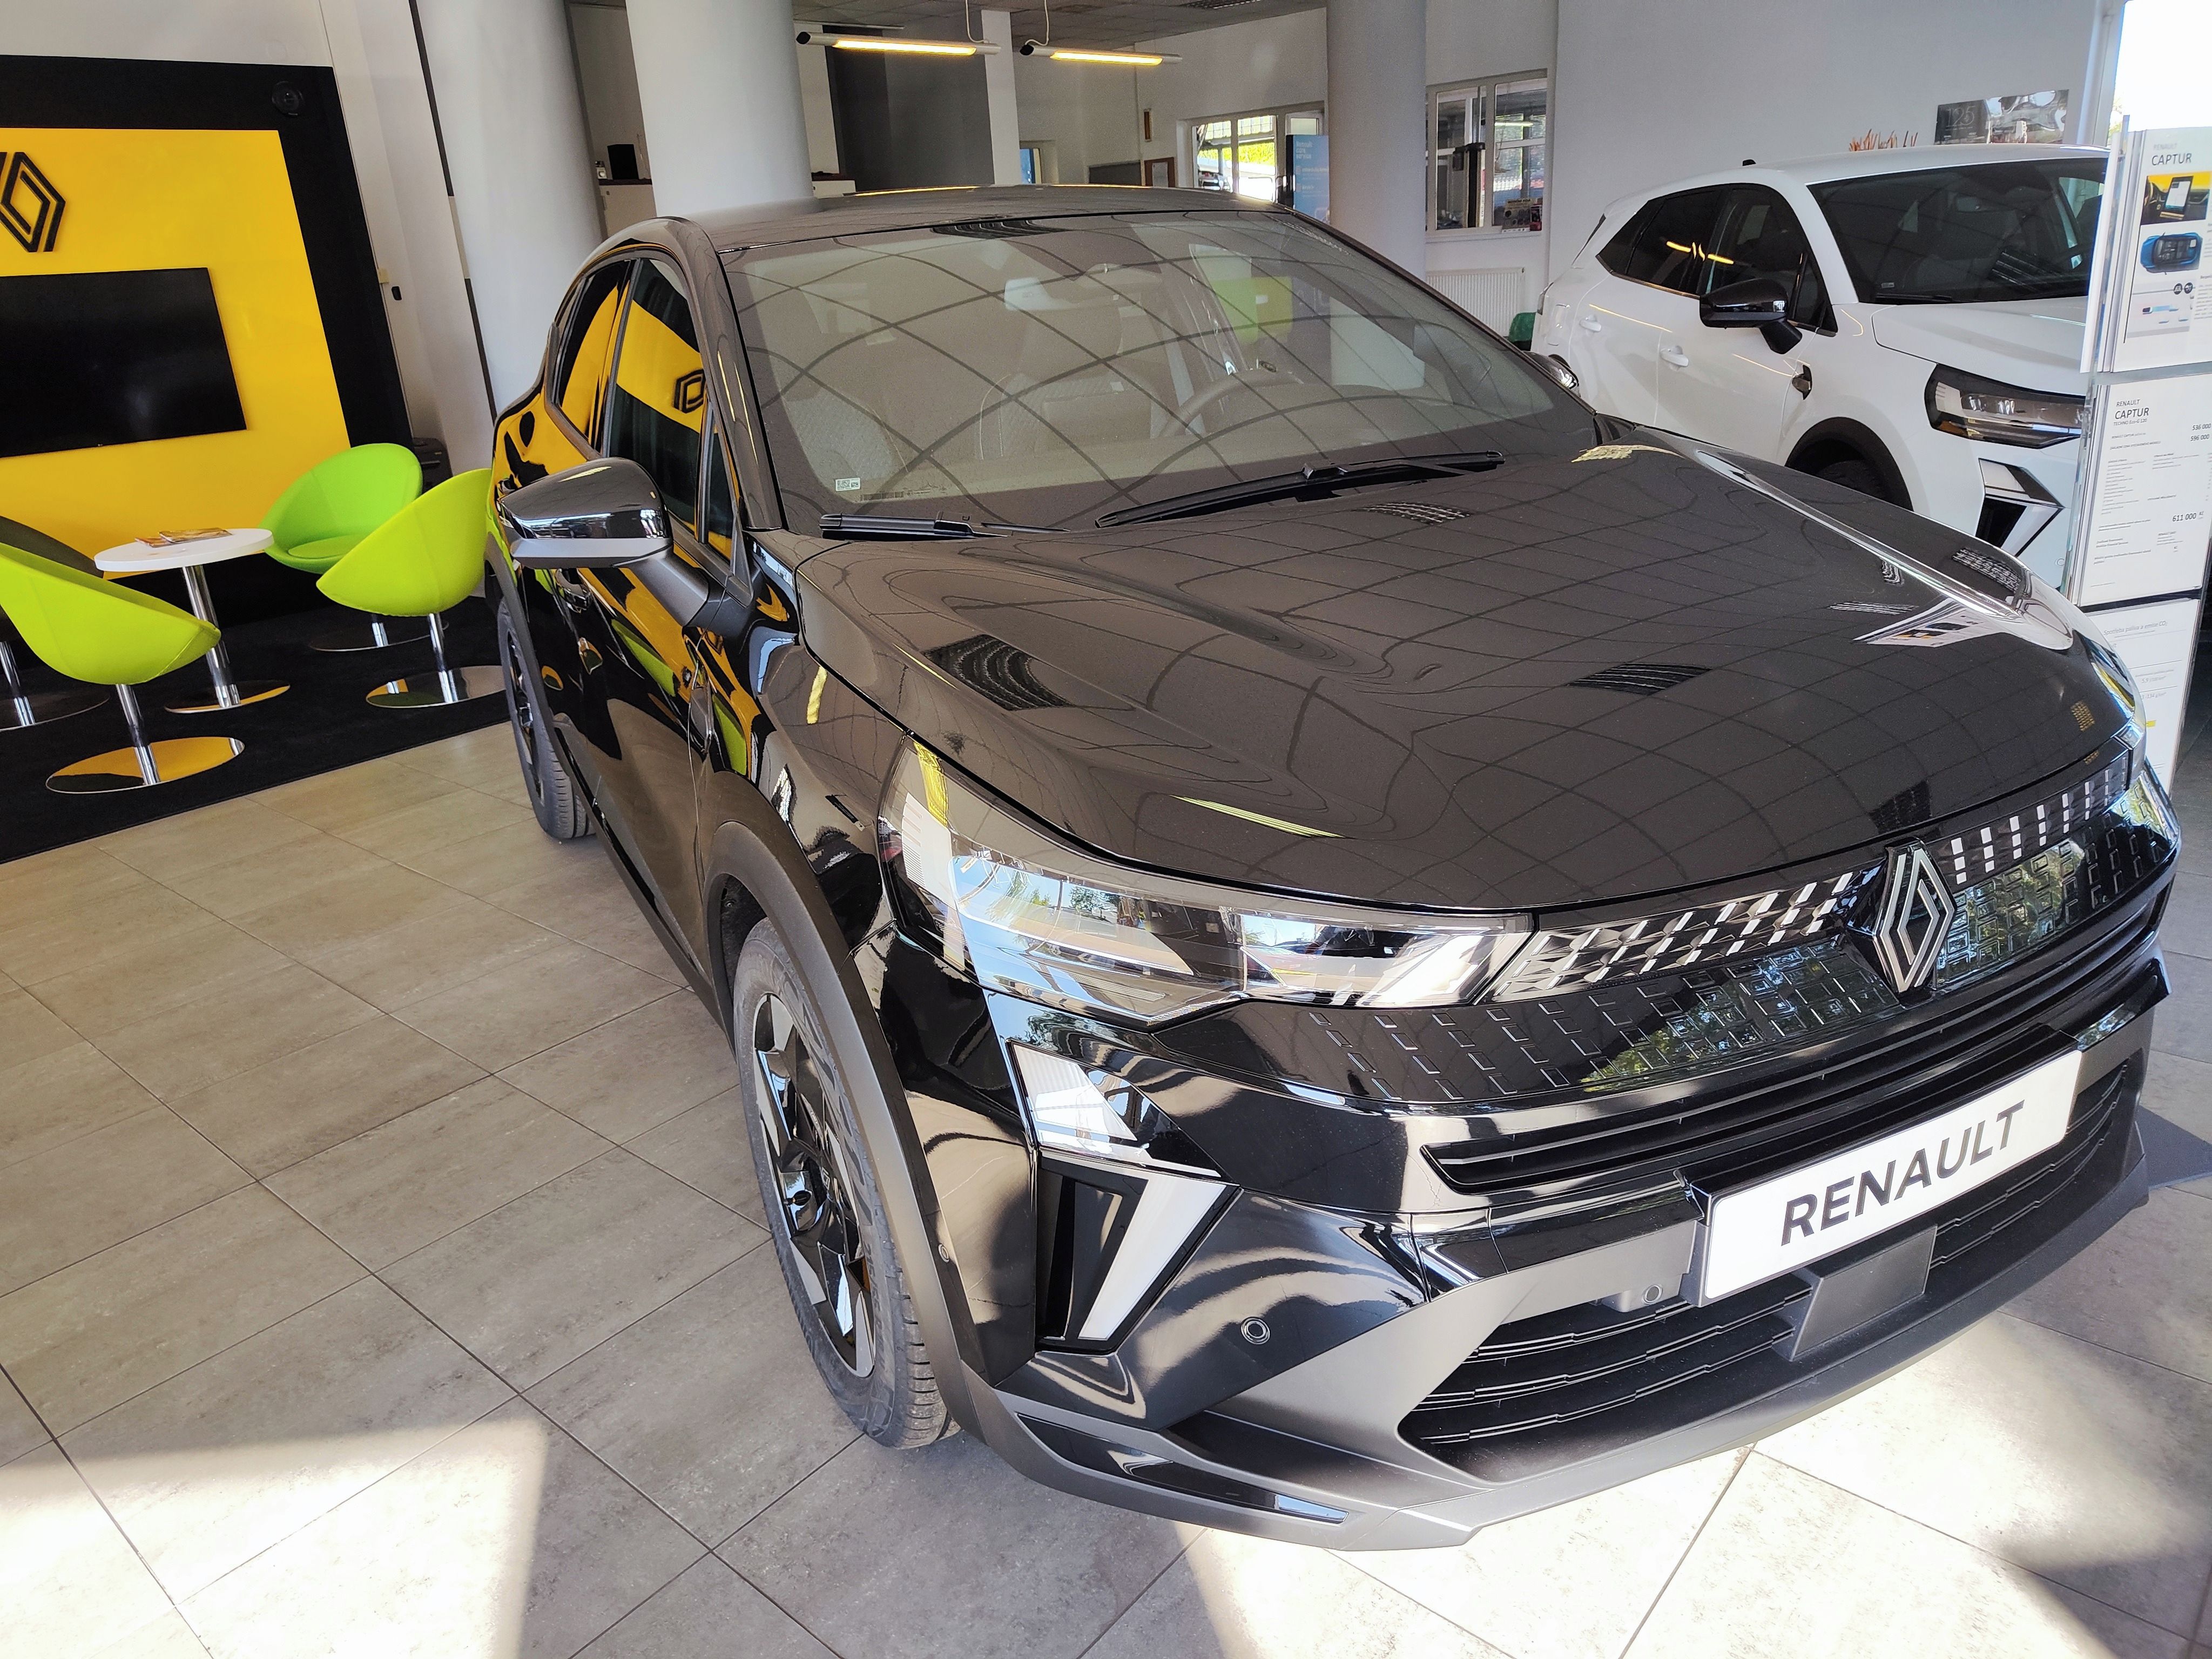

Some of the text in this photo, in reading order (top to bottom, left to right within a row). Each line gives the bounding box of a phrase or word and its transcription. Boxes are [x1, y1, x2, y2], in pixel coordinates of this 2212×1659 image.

[2152, 153, 2192, 166] CAPTUR
[2116, 399, 2141, 407] RENAULT
[2115, 407, 2149, 420] CAPTUR
[1781, 1100, 2025, 1246] RENAULT
